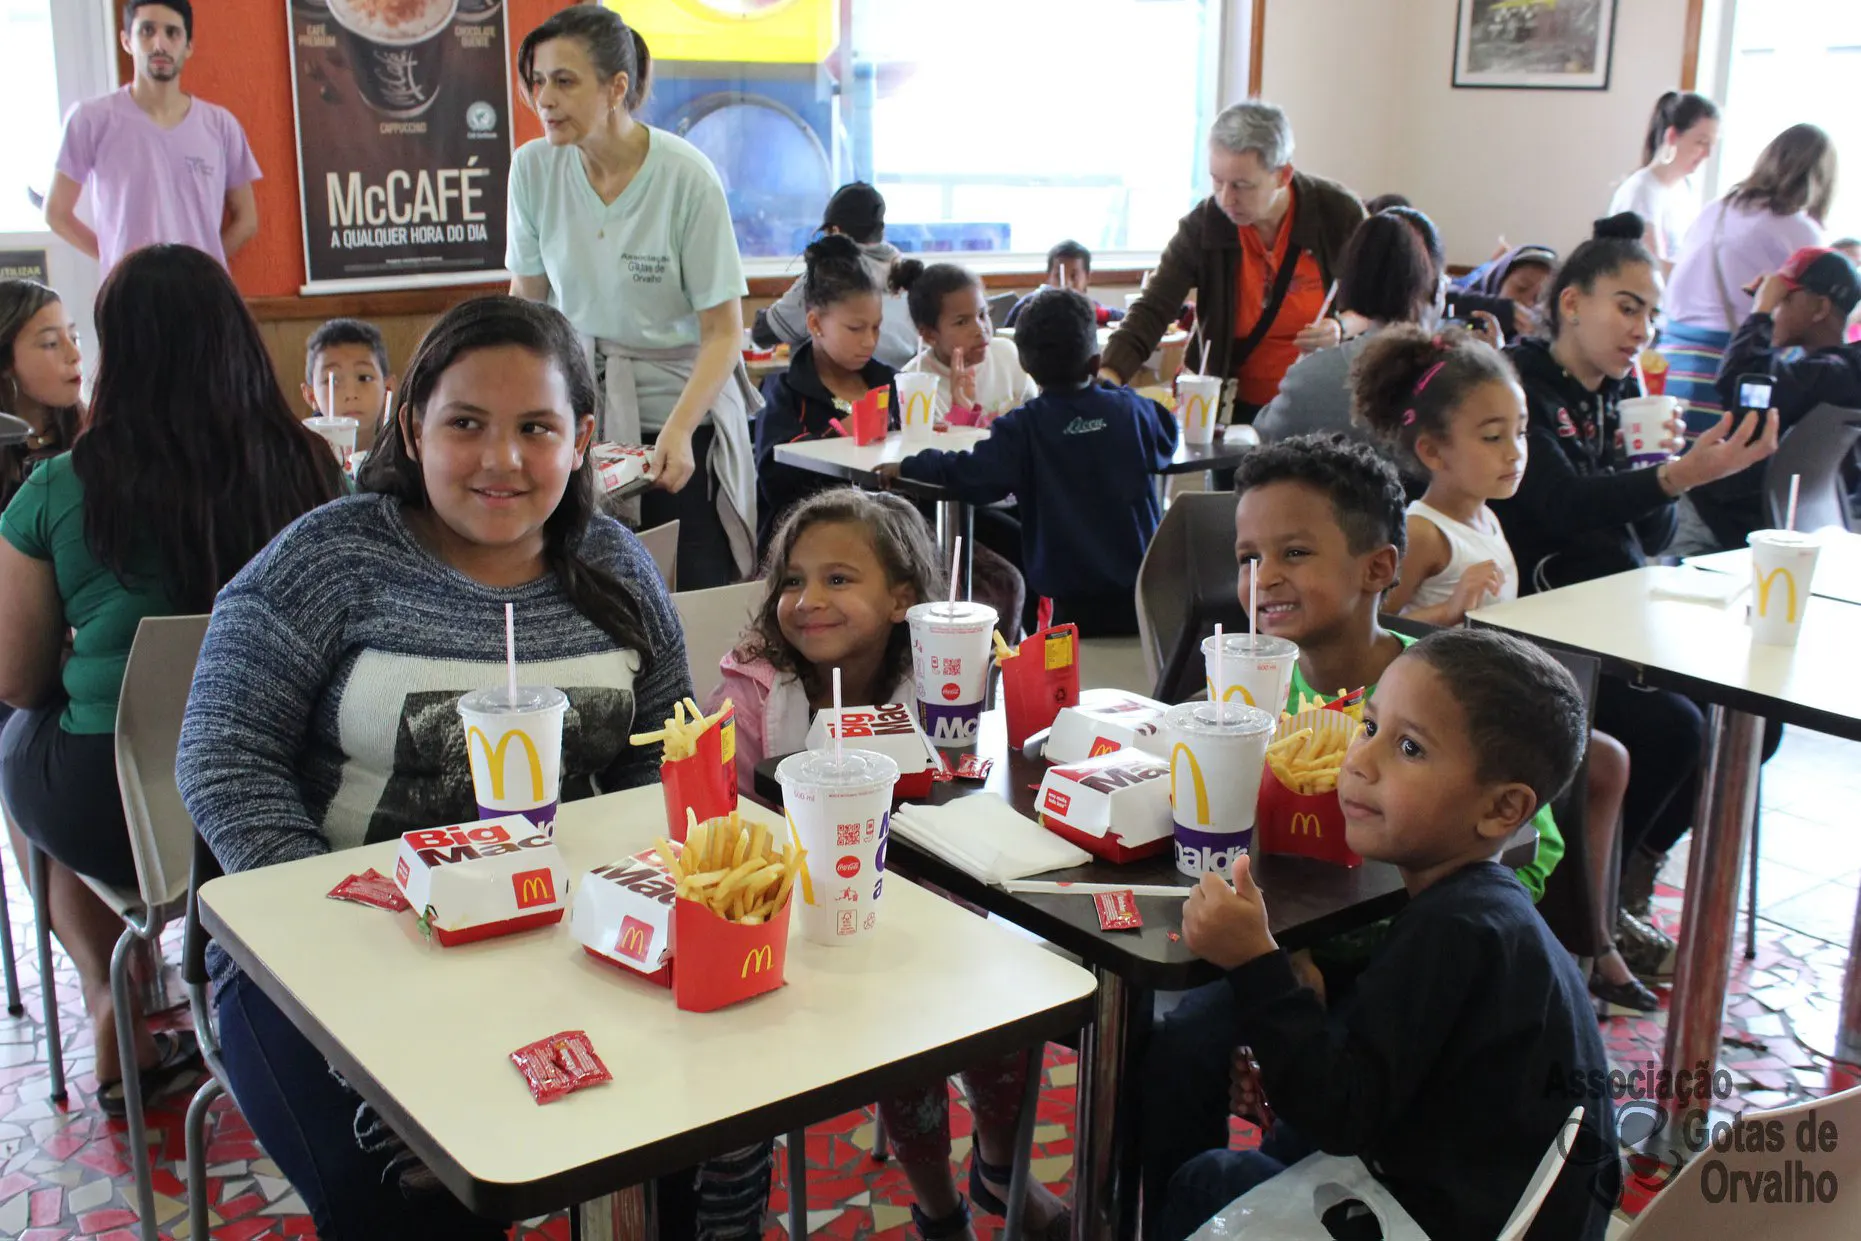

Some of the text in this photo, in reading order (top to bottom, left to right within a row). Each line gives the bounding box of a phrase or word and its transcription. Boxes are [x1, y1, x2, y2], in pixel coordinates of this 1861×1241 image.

[326, 155, 490, 227] McCAFÉ
[331, 223, 487, 249] A QUALQUER HORA DO DIA
[871, 703, 916, 735] Mac
[403, 825, 511, 851] Big
[416, 834, 554, 870] Mac
